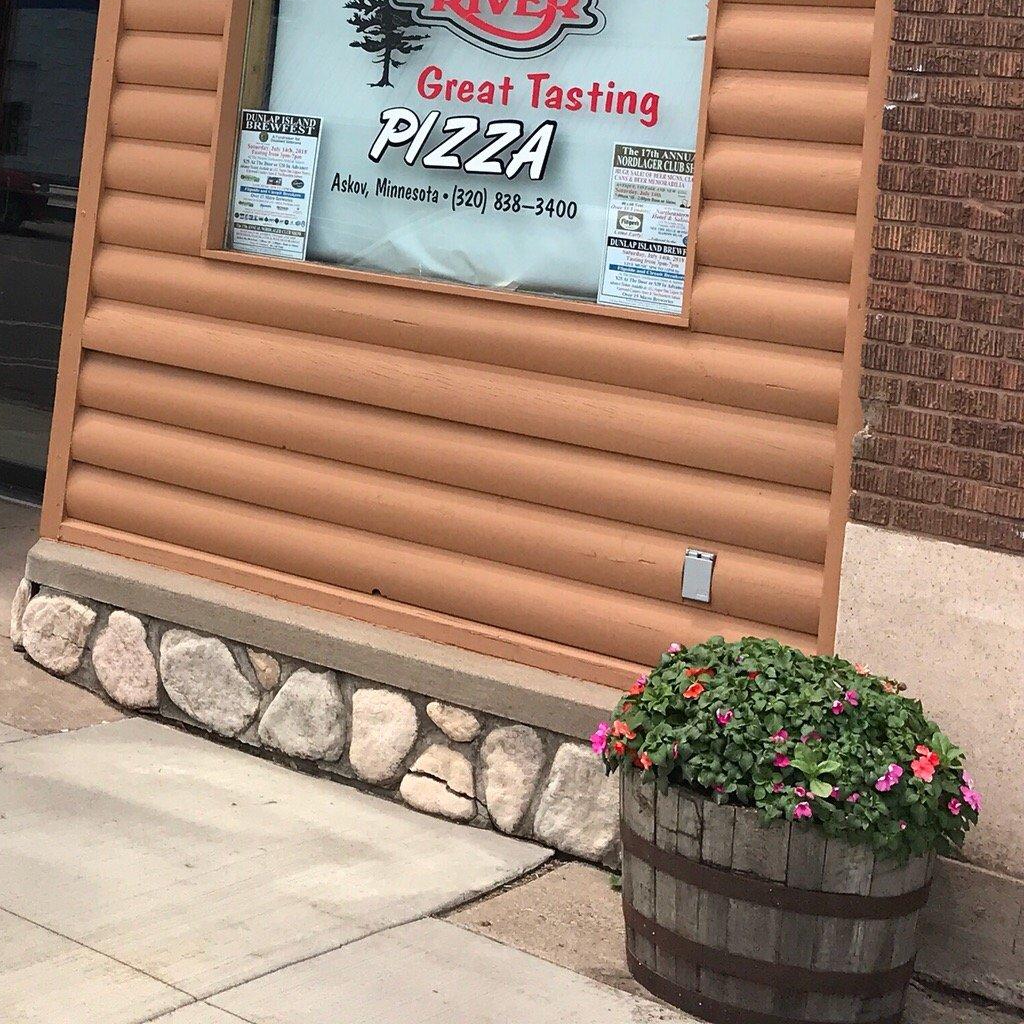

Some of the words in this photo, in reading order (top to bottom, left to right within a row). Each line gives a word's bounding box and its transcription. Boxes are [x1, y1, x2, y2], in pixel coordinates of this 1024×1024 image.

[416, 65, 514, 106] Great
[527, 73, 661, 128] Tasting
[245, 112, 279, 124] DUNLAP
[281, 116, 316, 127] ISLAND
[245, 120, 314, 135] BREWFEST
[367, 106, 558, 181] PIZZA
[622, 147, 639, 156] The
[641, 149, 659, 158] 17th
[617, 155, 663, 171] NORDLAGER
[663, 160, 685, 172] CLUB
[330, 173, 369, 199] Askov,
[375, 178, 440, 204] Minnesota
[451, 185, 488, 214] (320)
[609, 238, 637, 249] DUNLAP
[637, 241, 662, 252] ISLAND
